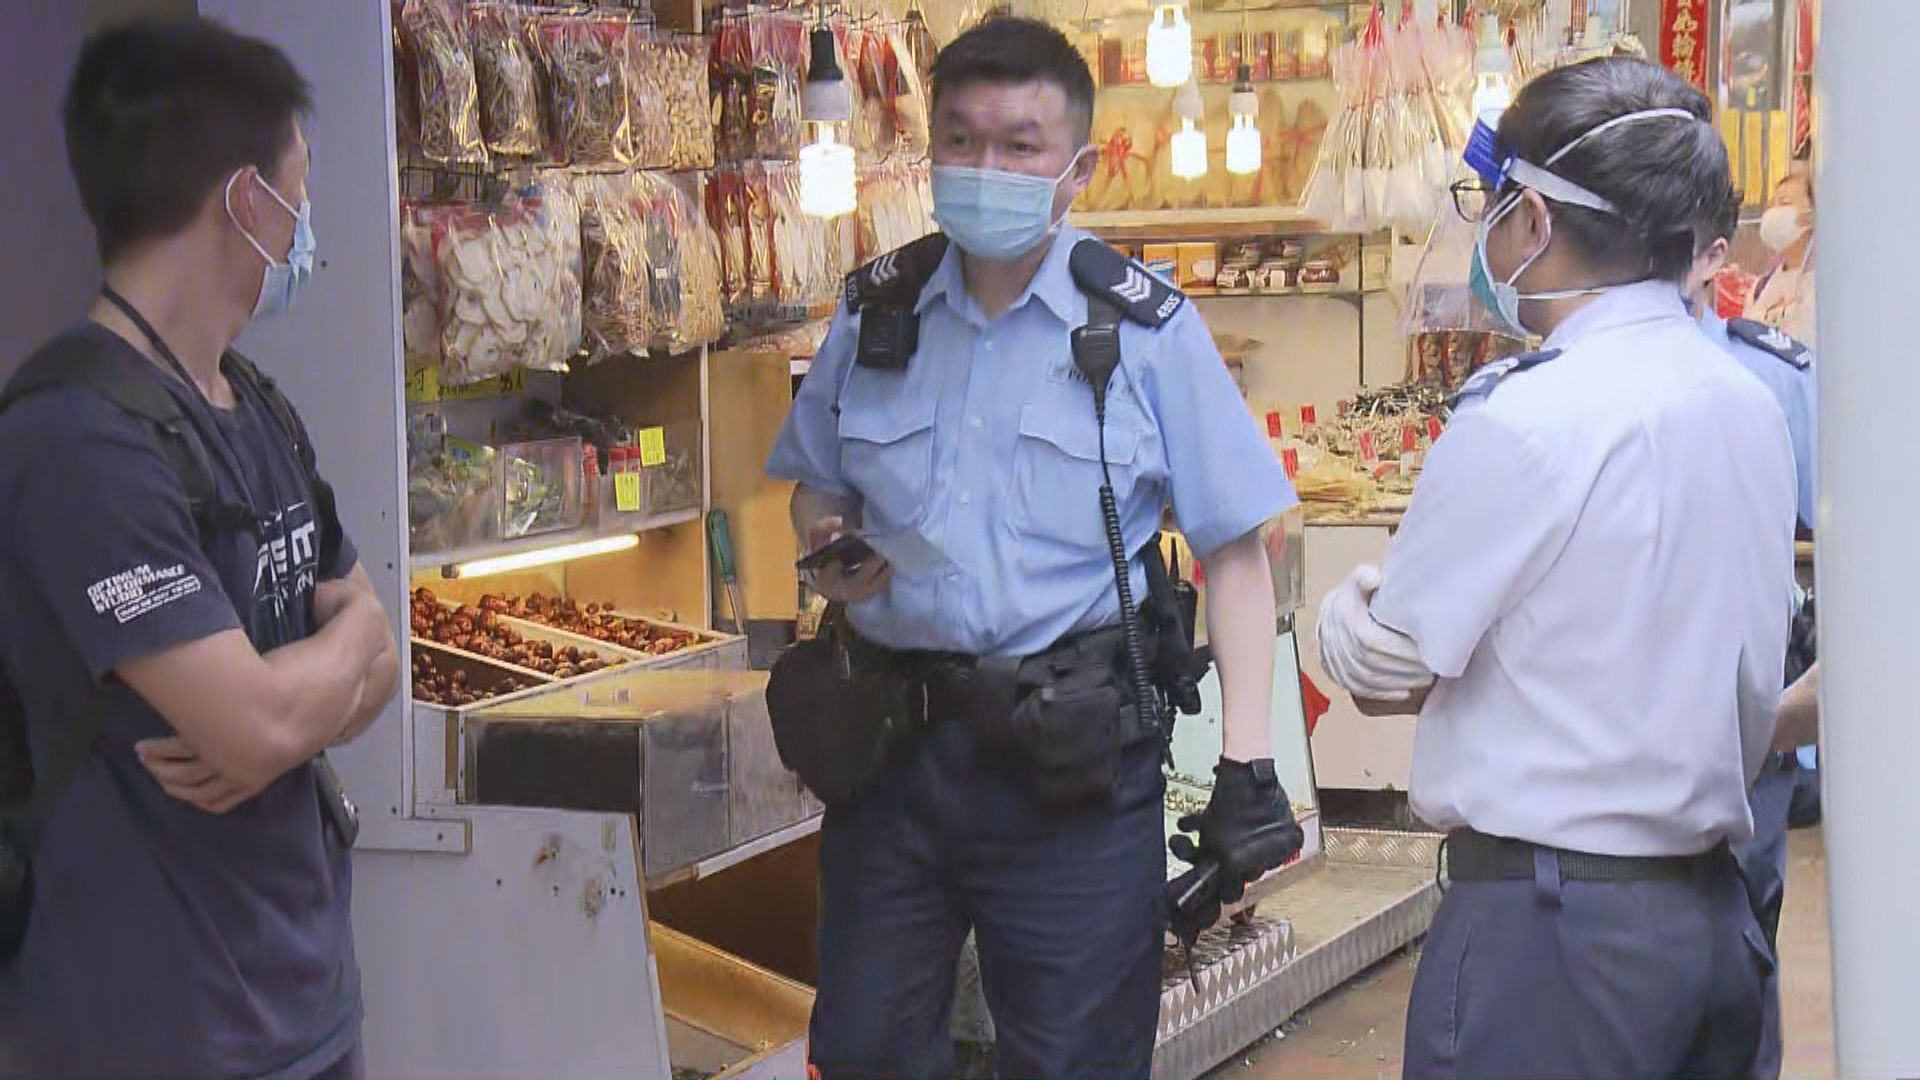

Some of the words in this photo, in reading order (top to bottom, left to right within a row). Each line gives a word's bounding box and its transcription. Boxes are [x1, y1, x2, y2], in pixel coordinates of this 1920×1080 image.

[87, 563, 152, 598] OPTIMUM
[91, 563, 185, 605] PERFORMANCE
[95, 586, 144, 615] STUDIO
